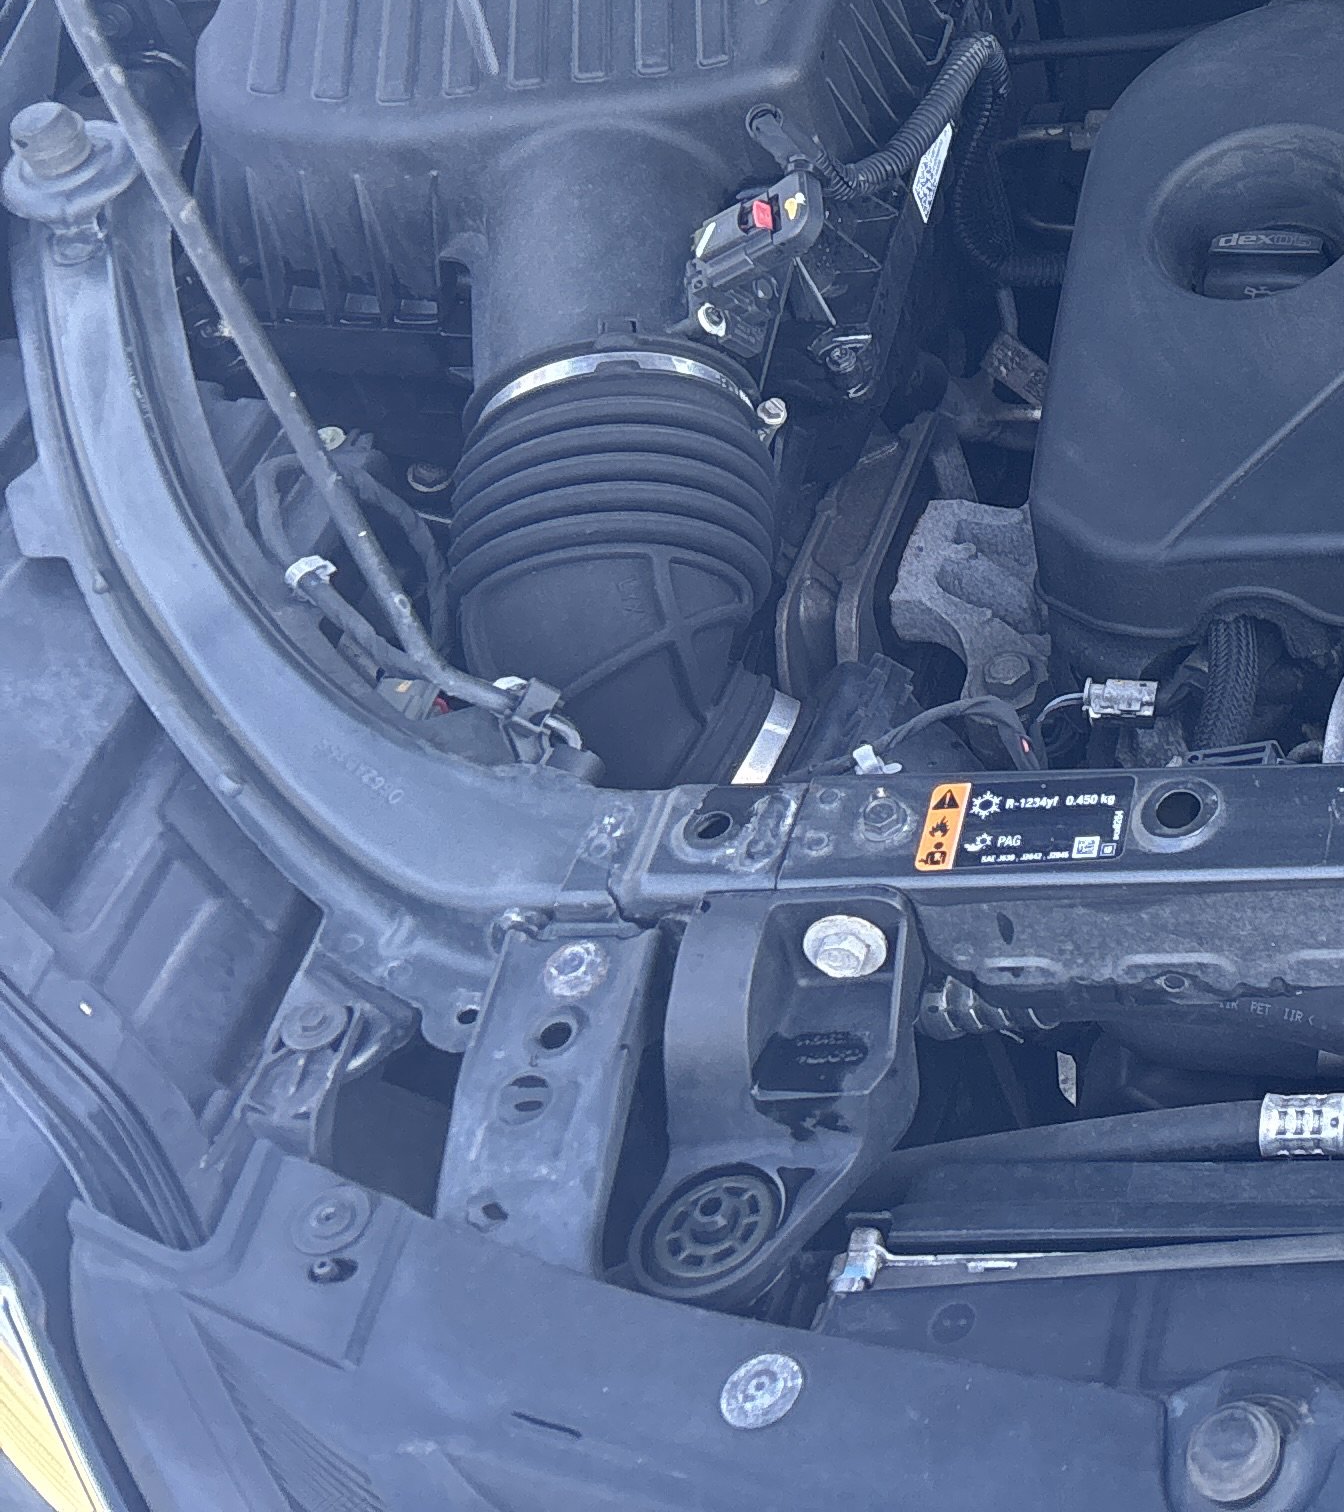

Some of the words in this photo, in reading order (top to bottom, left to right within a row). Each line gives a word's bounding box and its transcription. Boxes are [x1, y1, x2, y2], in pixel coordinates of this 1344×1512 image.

[1004, 795, 1060, 809] R-1234yf
[1065, 793, 1099, 806] 0.450
[1099, 793, 1117, 806] kg
[996, 834, 1022, 848] PAG
[1249, 1000, 1272, 1016] PET
